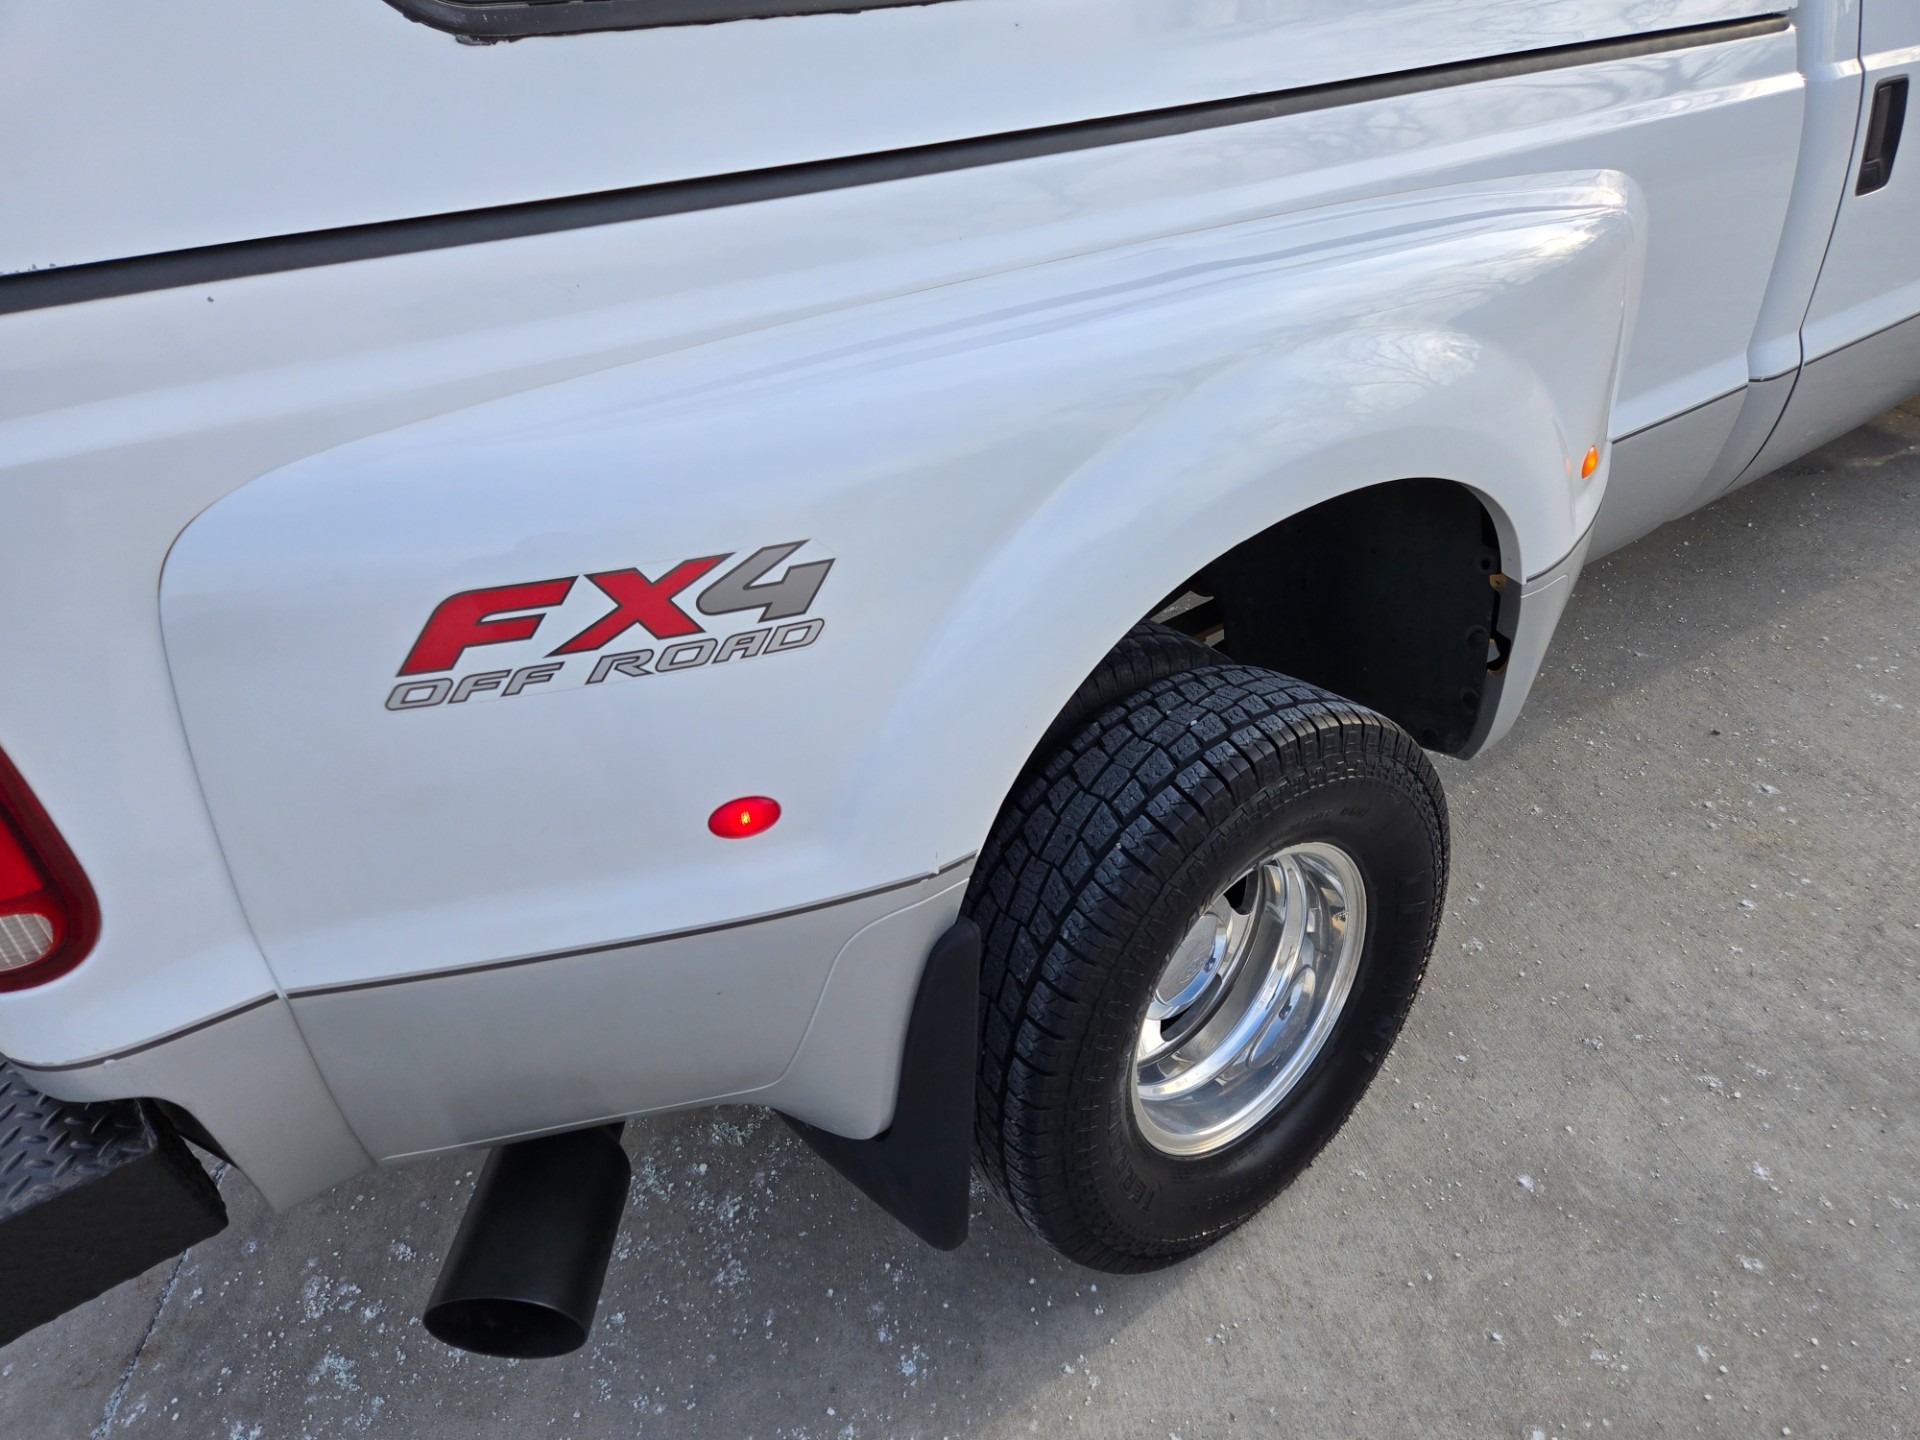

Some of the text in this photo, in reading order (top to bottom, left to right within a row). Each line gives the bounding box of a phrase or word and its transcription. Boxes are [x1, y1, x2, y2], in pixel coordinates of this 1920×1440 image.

[384, 618, 825, 711] OFF ROAD
[396, 539, 836, 677] FX4
